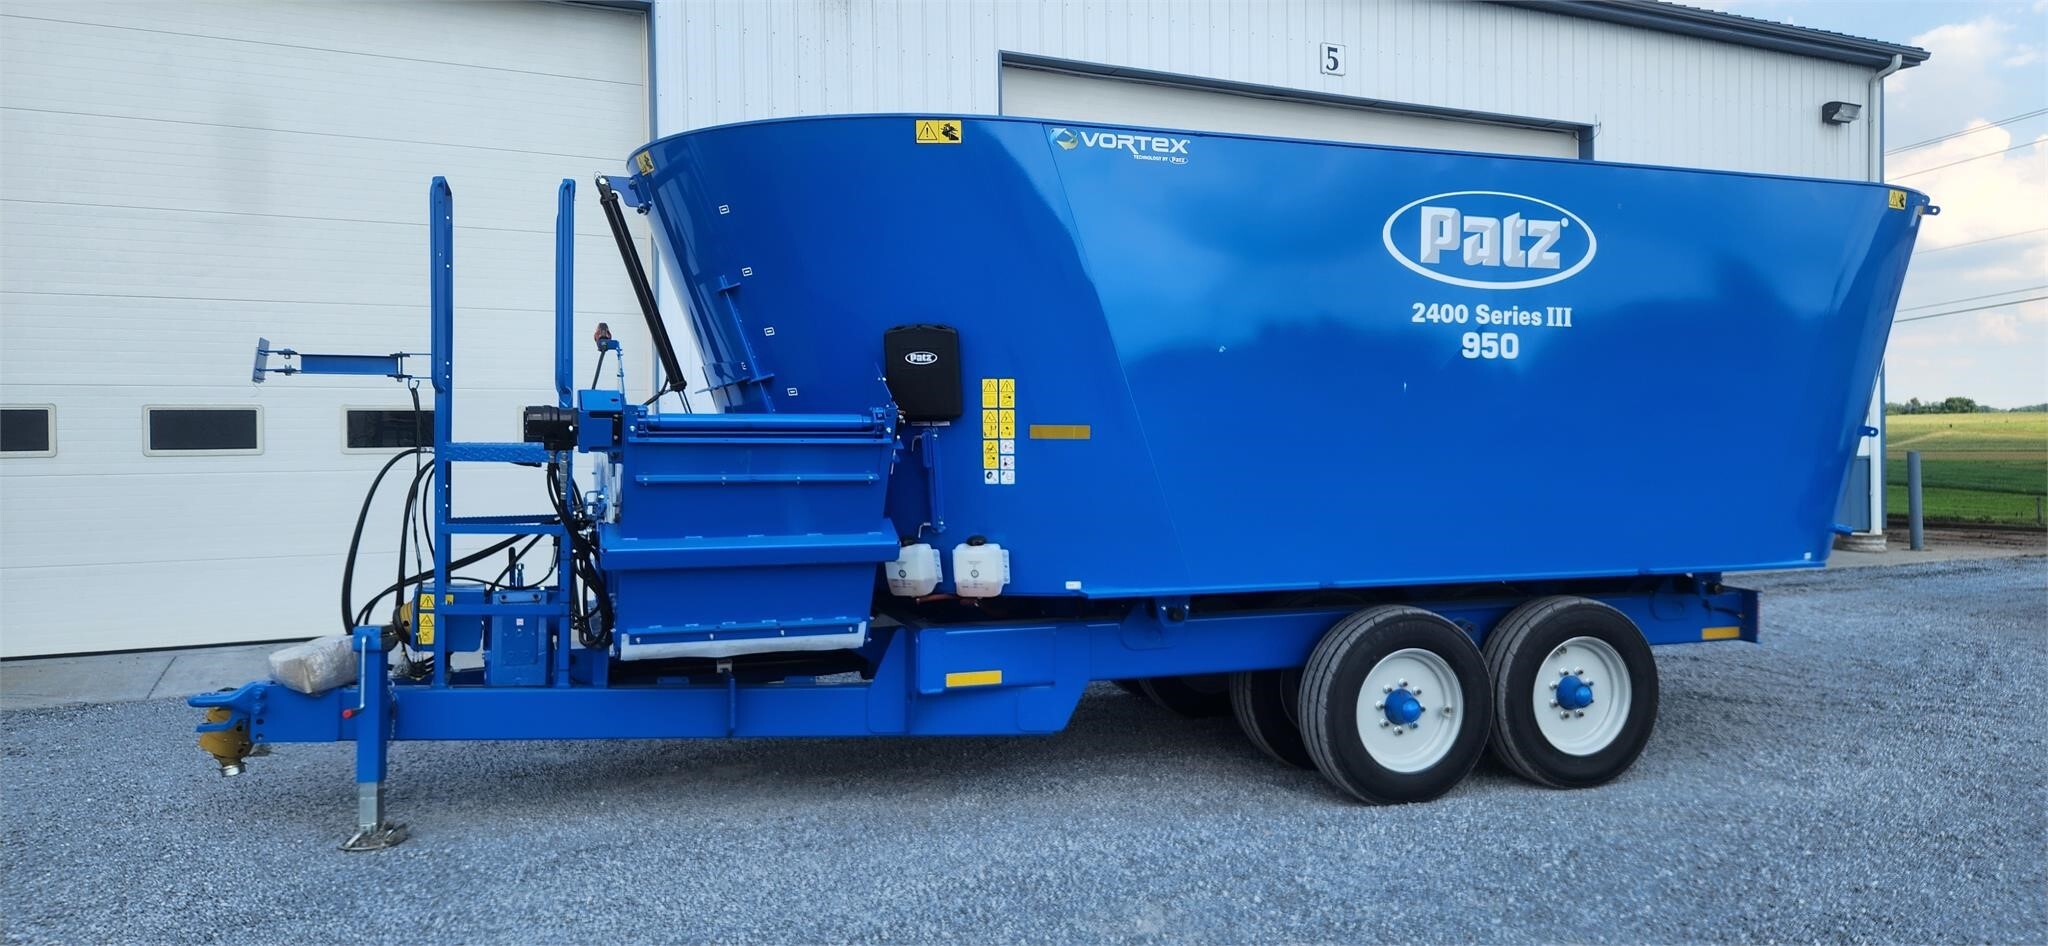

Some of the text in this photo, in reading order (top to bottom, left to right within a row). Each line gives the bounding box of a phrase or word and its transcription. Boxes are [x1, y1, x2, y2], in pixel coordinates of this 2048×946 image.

[1326, 46, 1338, 70] 5
[1420, 206, 1561, 269] Patz
[1411, 302, 1572, 327] 2400 Series III
[910, 353, 932, 362] Patz
[1462, 331, 1519, 359] 950
